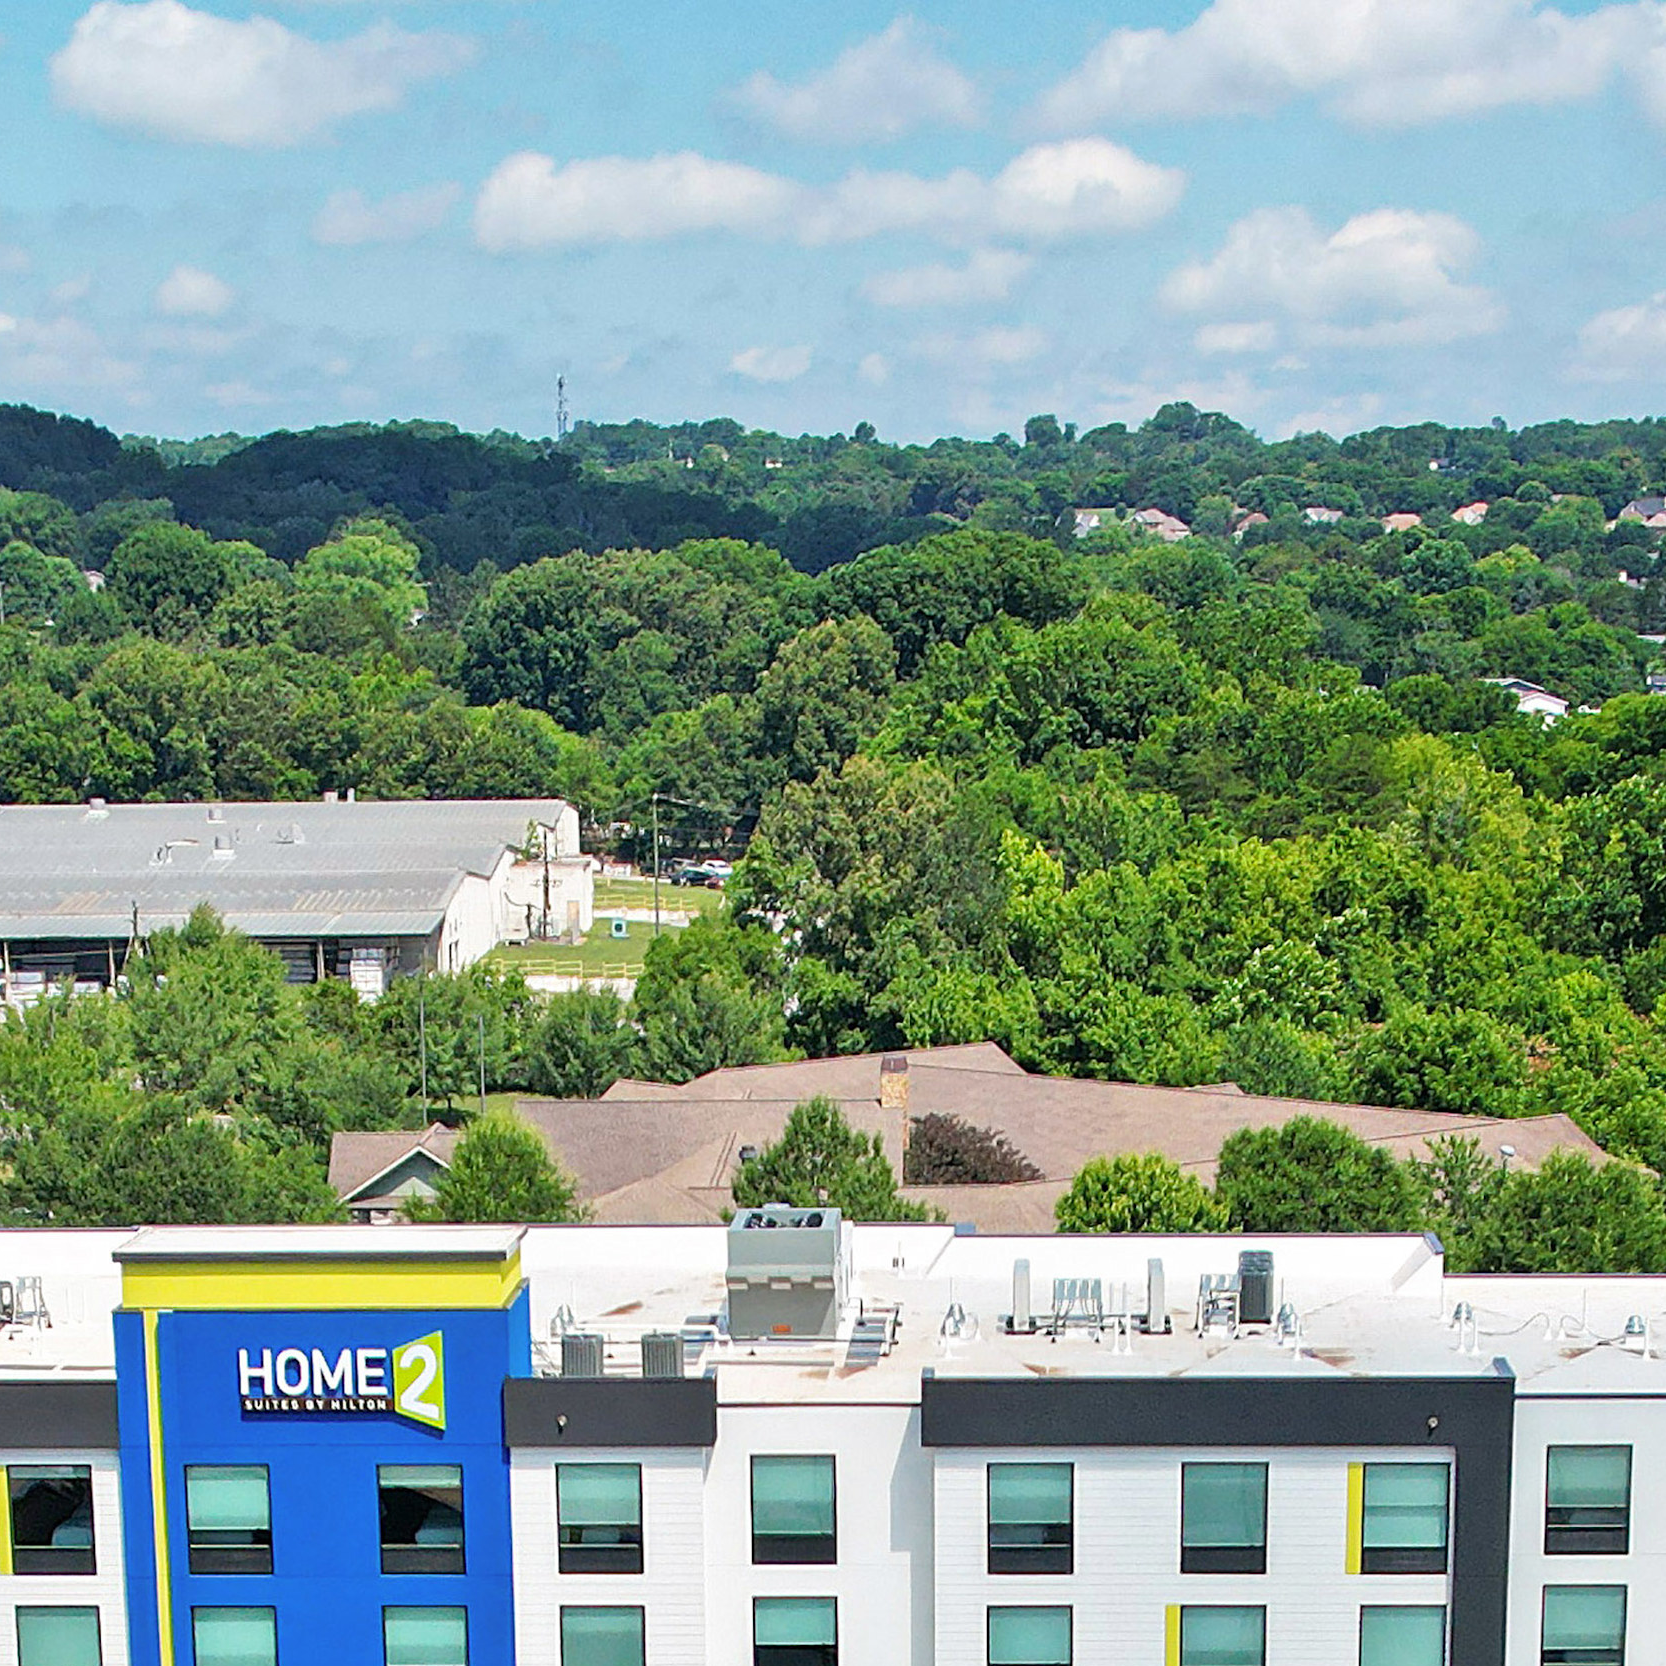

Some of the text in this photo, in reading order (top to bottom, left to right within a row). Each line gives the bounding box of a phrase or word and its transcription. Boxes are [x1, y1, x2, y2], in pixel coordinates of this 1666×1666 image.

[238, 1344, 440, 1419] HOME 2
[244, 1399, 387, 1410] SUITES BY HILTON
